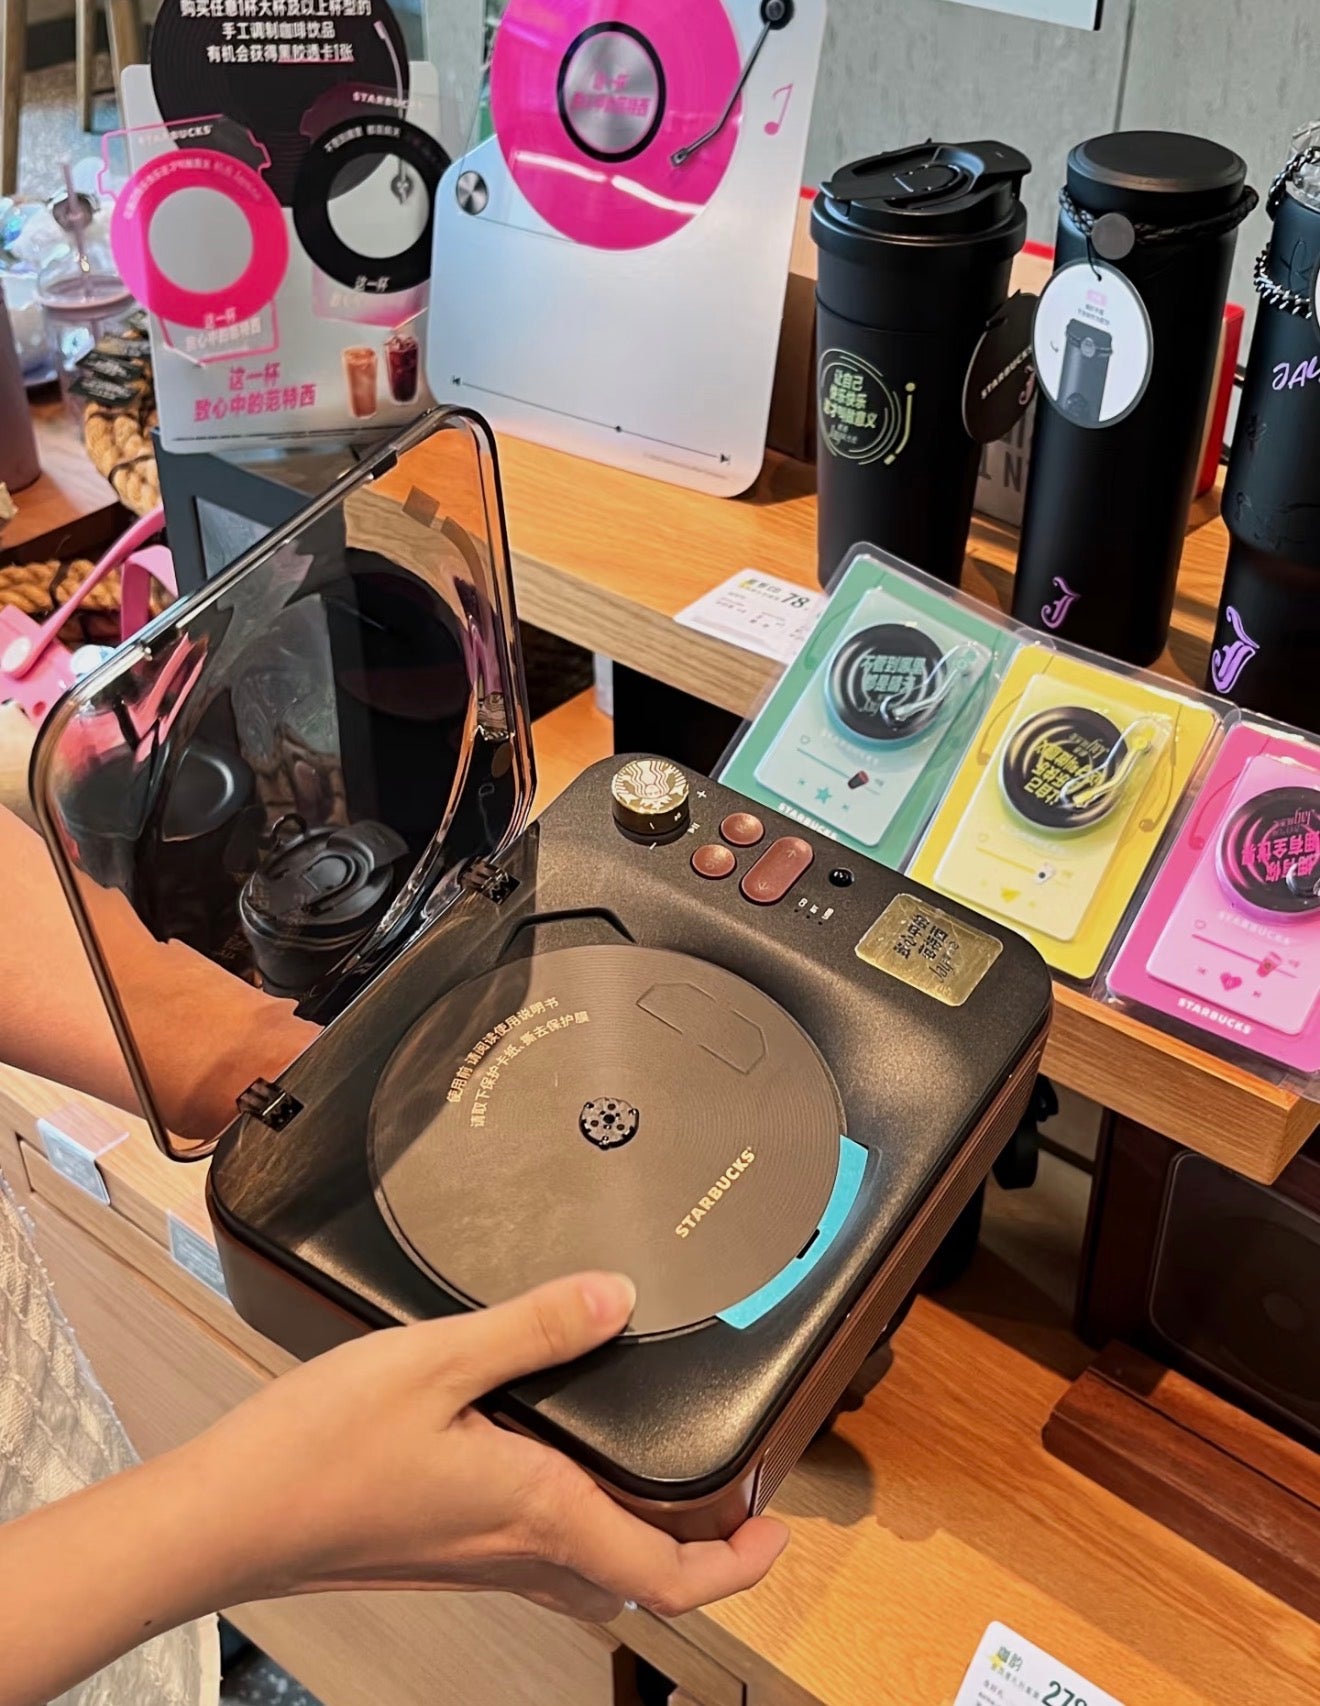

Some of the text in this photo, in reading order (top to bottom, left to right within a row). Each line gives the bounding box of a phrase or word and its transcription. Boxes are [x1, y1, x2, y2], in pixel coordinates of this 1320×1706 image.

[222, 21, 336, 40] 手工调制咖啡饮品
[229, 362, 281, 391] 这一杯
[1177, 997, 1252, 1036] STARBUCKS
[675, 1148, 755, 1238] STARBUCKS
